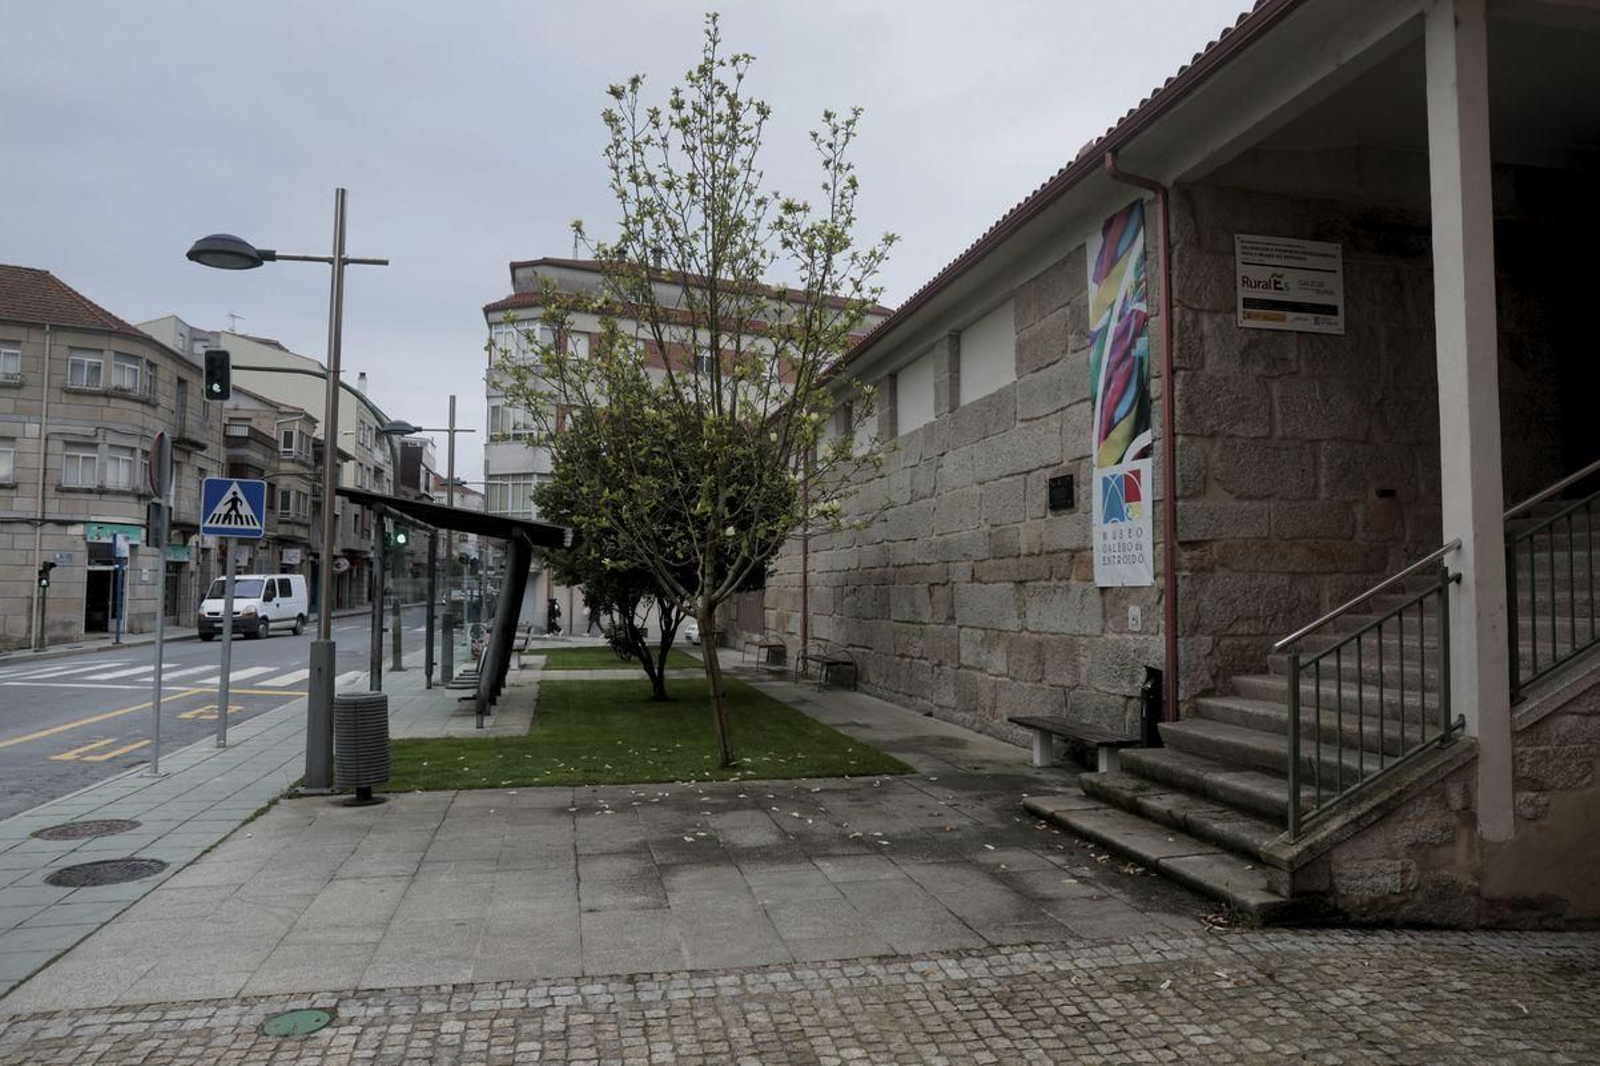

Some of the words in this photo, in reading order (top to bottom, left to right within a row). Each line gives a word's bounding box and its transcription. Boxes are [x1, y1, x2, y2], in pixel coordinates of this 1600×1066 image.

[1102, 527, 1143, 540] MUSEO
[1102, 542, 1133, 553] GALEGO
[1102, 554, 1144, 566] ENTROIDO
